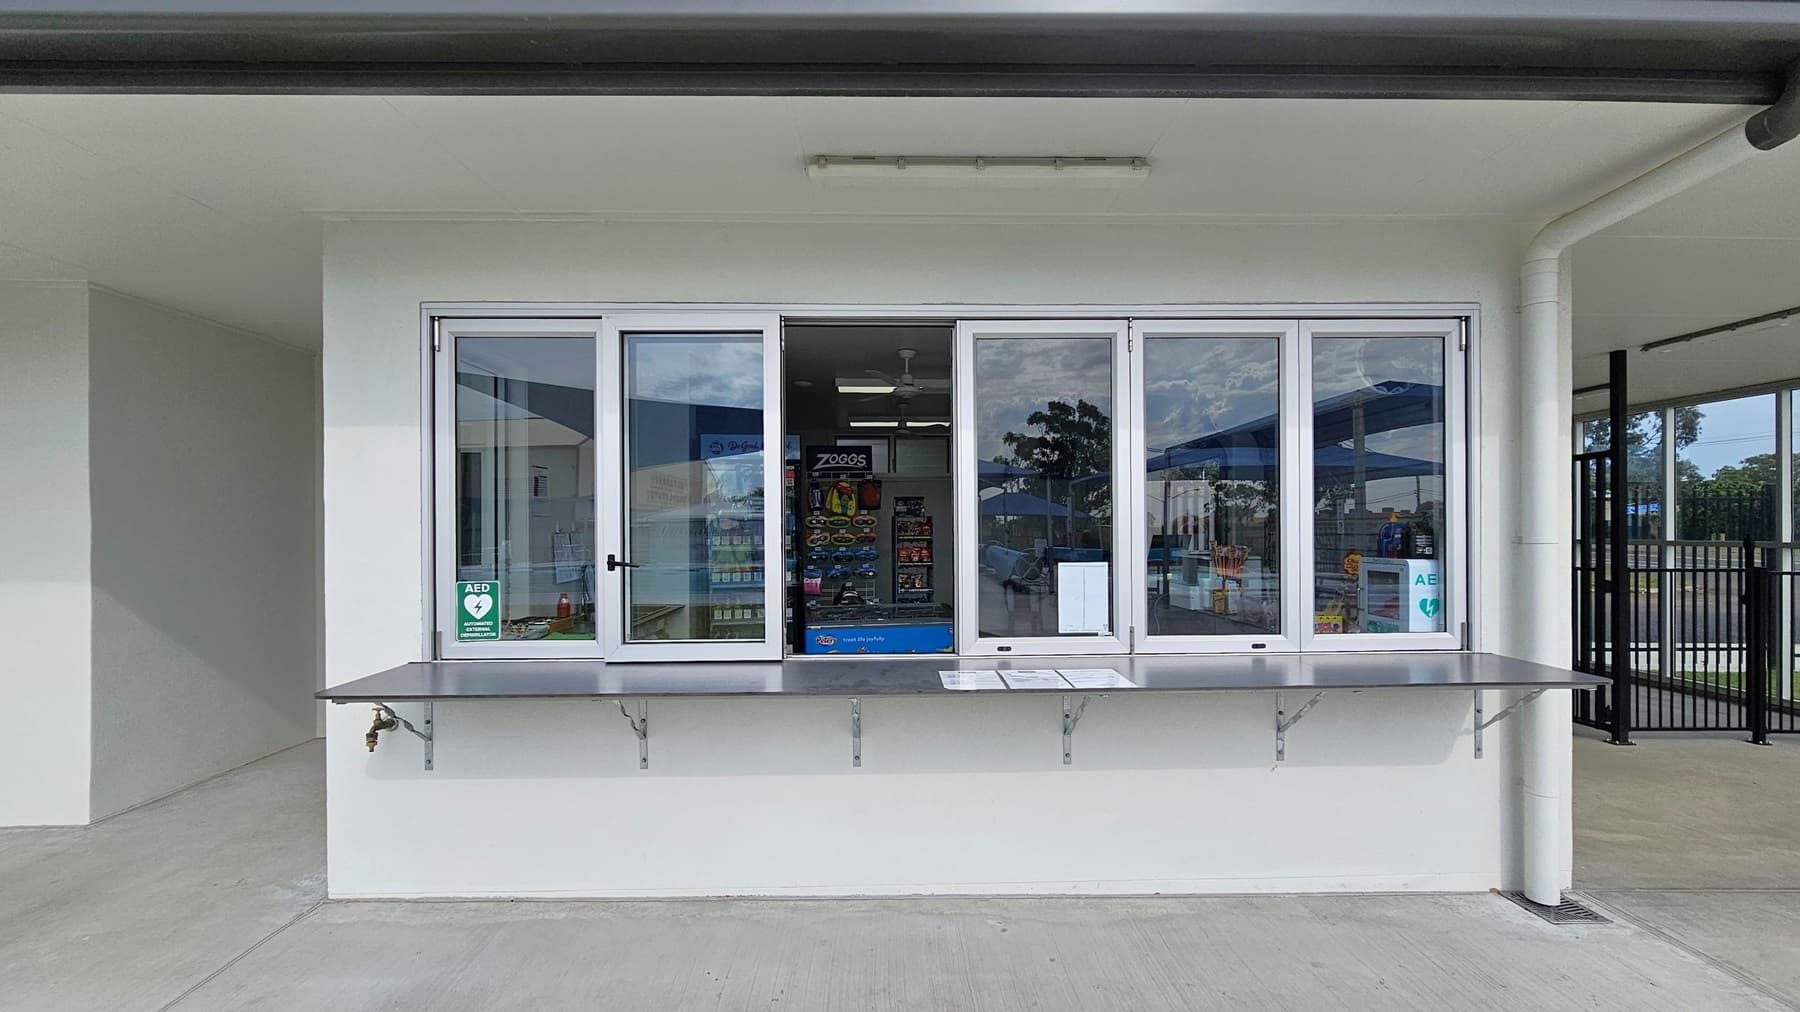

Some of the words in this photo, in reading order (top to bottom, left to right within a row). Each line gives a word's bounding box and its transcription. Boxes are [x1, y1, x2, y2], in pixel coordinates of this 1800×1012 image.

[812, 454, 866, 470] ZOGGS
[1415, 574, 1438, 585] AE
[465, 583, 490, 593] AED
